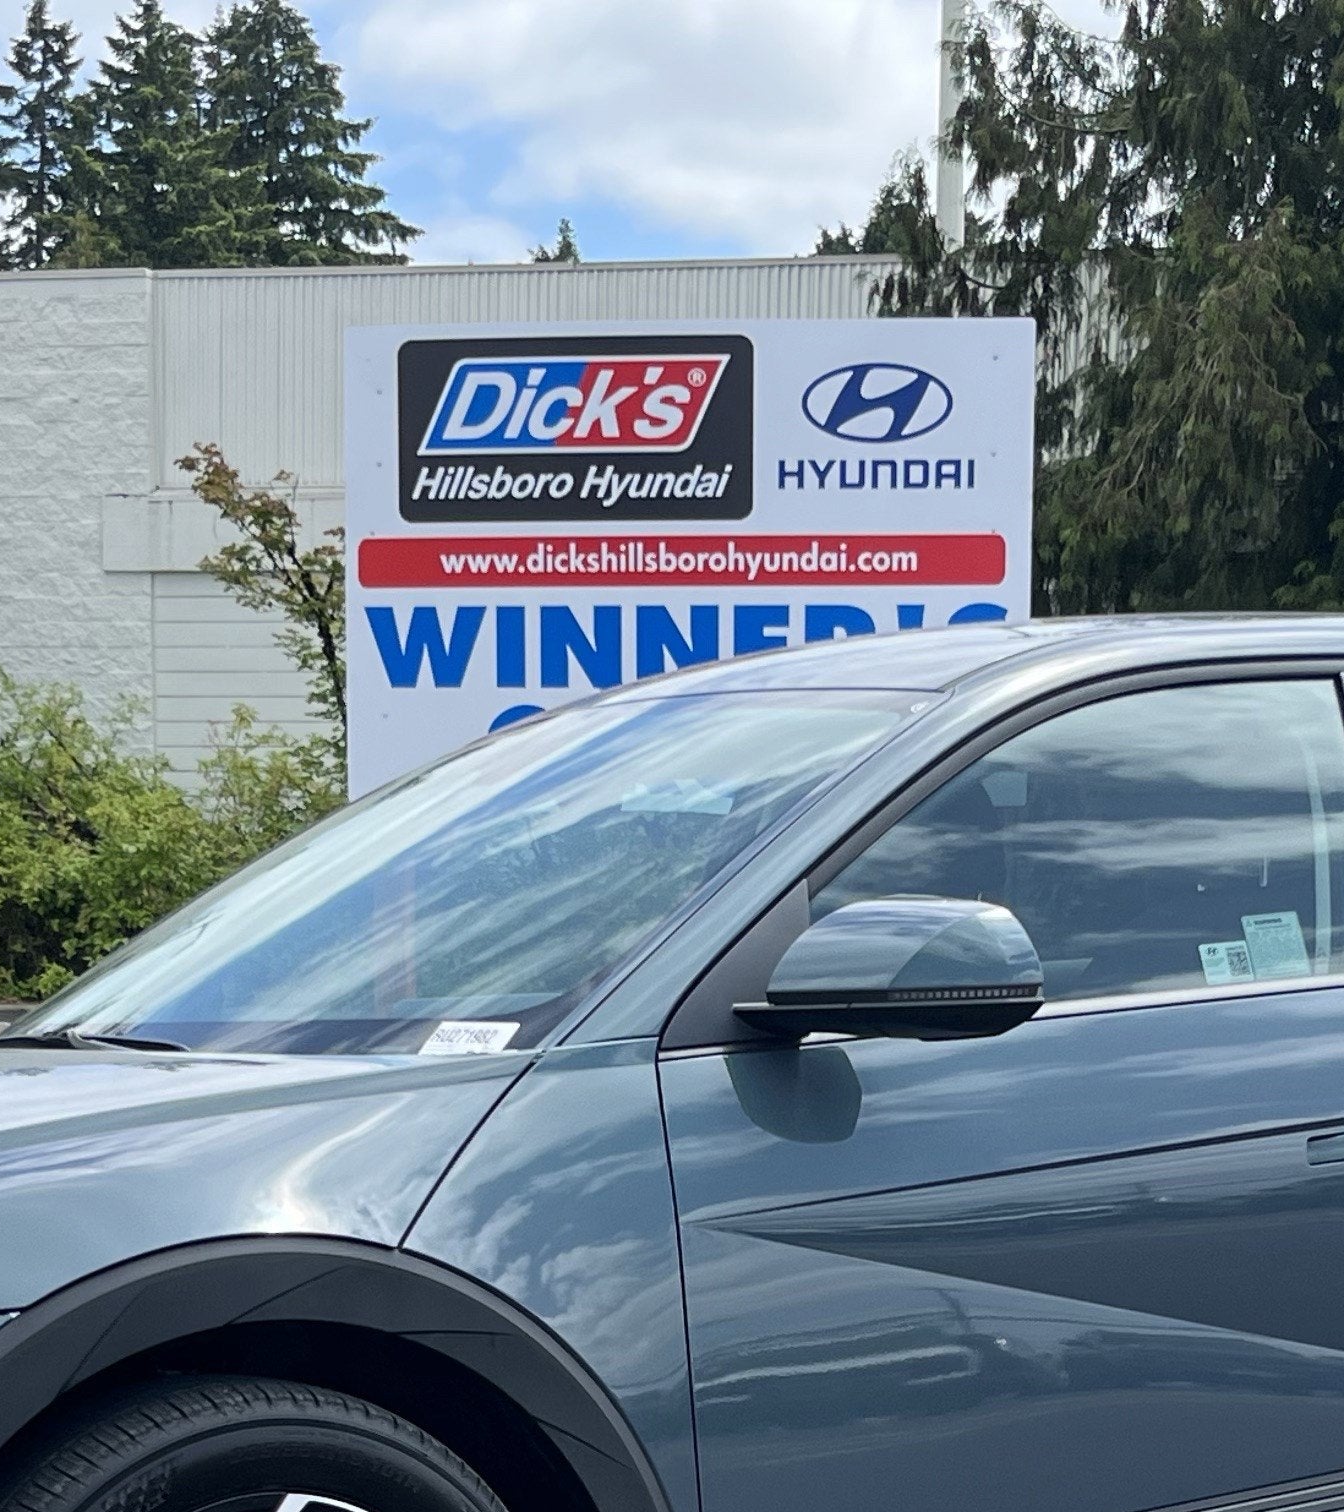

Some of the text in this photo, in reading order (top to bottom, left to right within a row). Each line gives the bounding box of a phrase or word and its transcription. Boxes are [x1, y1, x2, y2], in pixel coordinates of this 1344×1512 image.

[442, 366, 691, 441] Dick's
[411, 463, 733, 507] Hillsboro Hyundai
[778, 459, 975, 490] HYUNDAI
[439, 542, 919, 580] www.dickshillsborohyundai.com
[365, 603, 1008, 688] WINNE'
